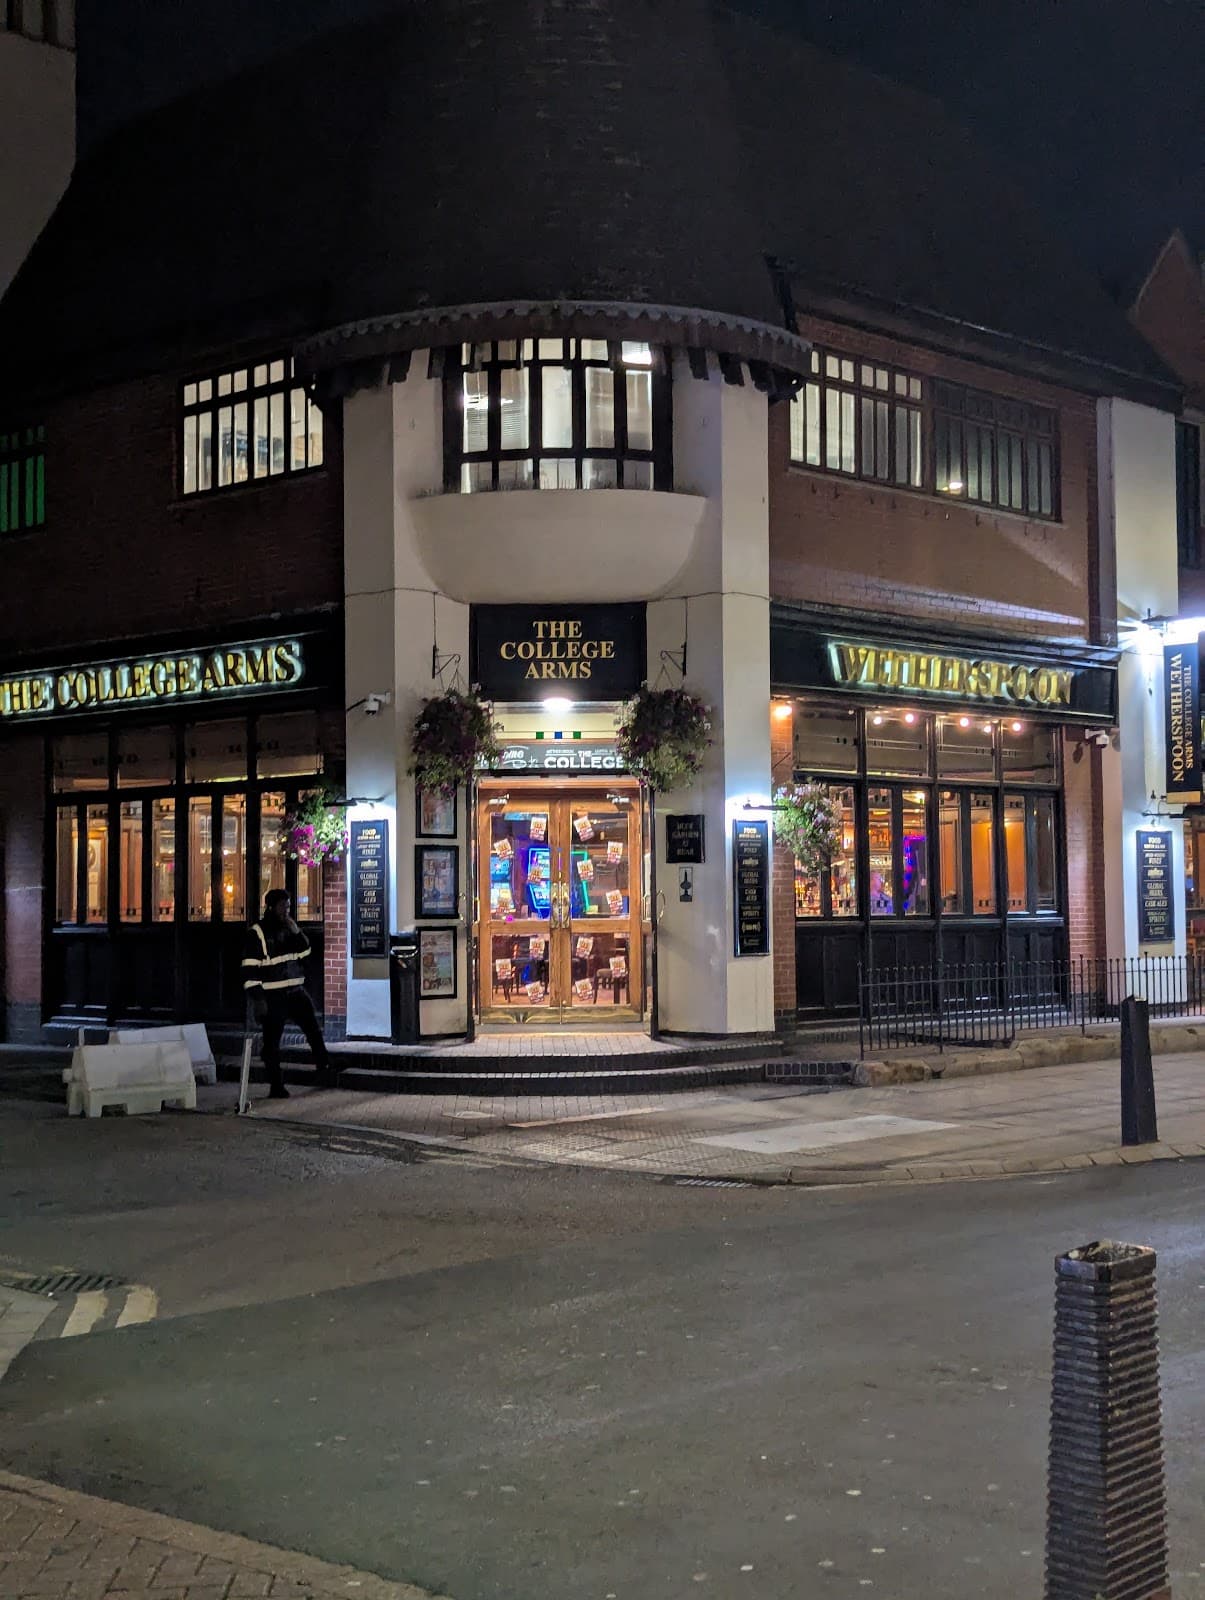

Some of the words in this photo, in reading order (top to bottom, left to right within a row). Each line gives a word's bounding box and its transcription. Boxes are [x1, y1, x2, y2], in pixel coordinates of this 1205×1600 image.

[533, 620, 582, 639] THE
[500, 640, 616, 660] COLLEGE
[57, 657, 201, 708] COLLEGE
[200, 640, 304, 692] ARMS
[524, 660, 592, 679] ARMS
[828, 642, 1074, 705] WETHERSPOON
[1184, 665, 1192, 687] THE
[1170, 653, 1184, 782] WETHERSPOON
[1184, 688, 1193, 737] COLLEGE
[544, 756, 624, 769] COLLEGE
[1185, 740, 1194, 769] ARMS
